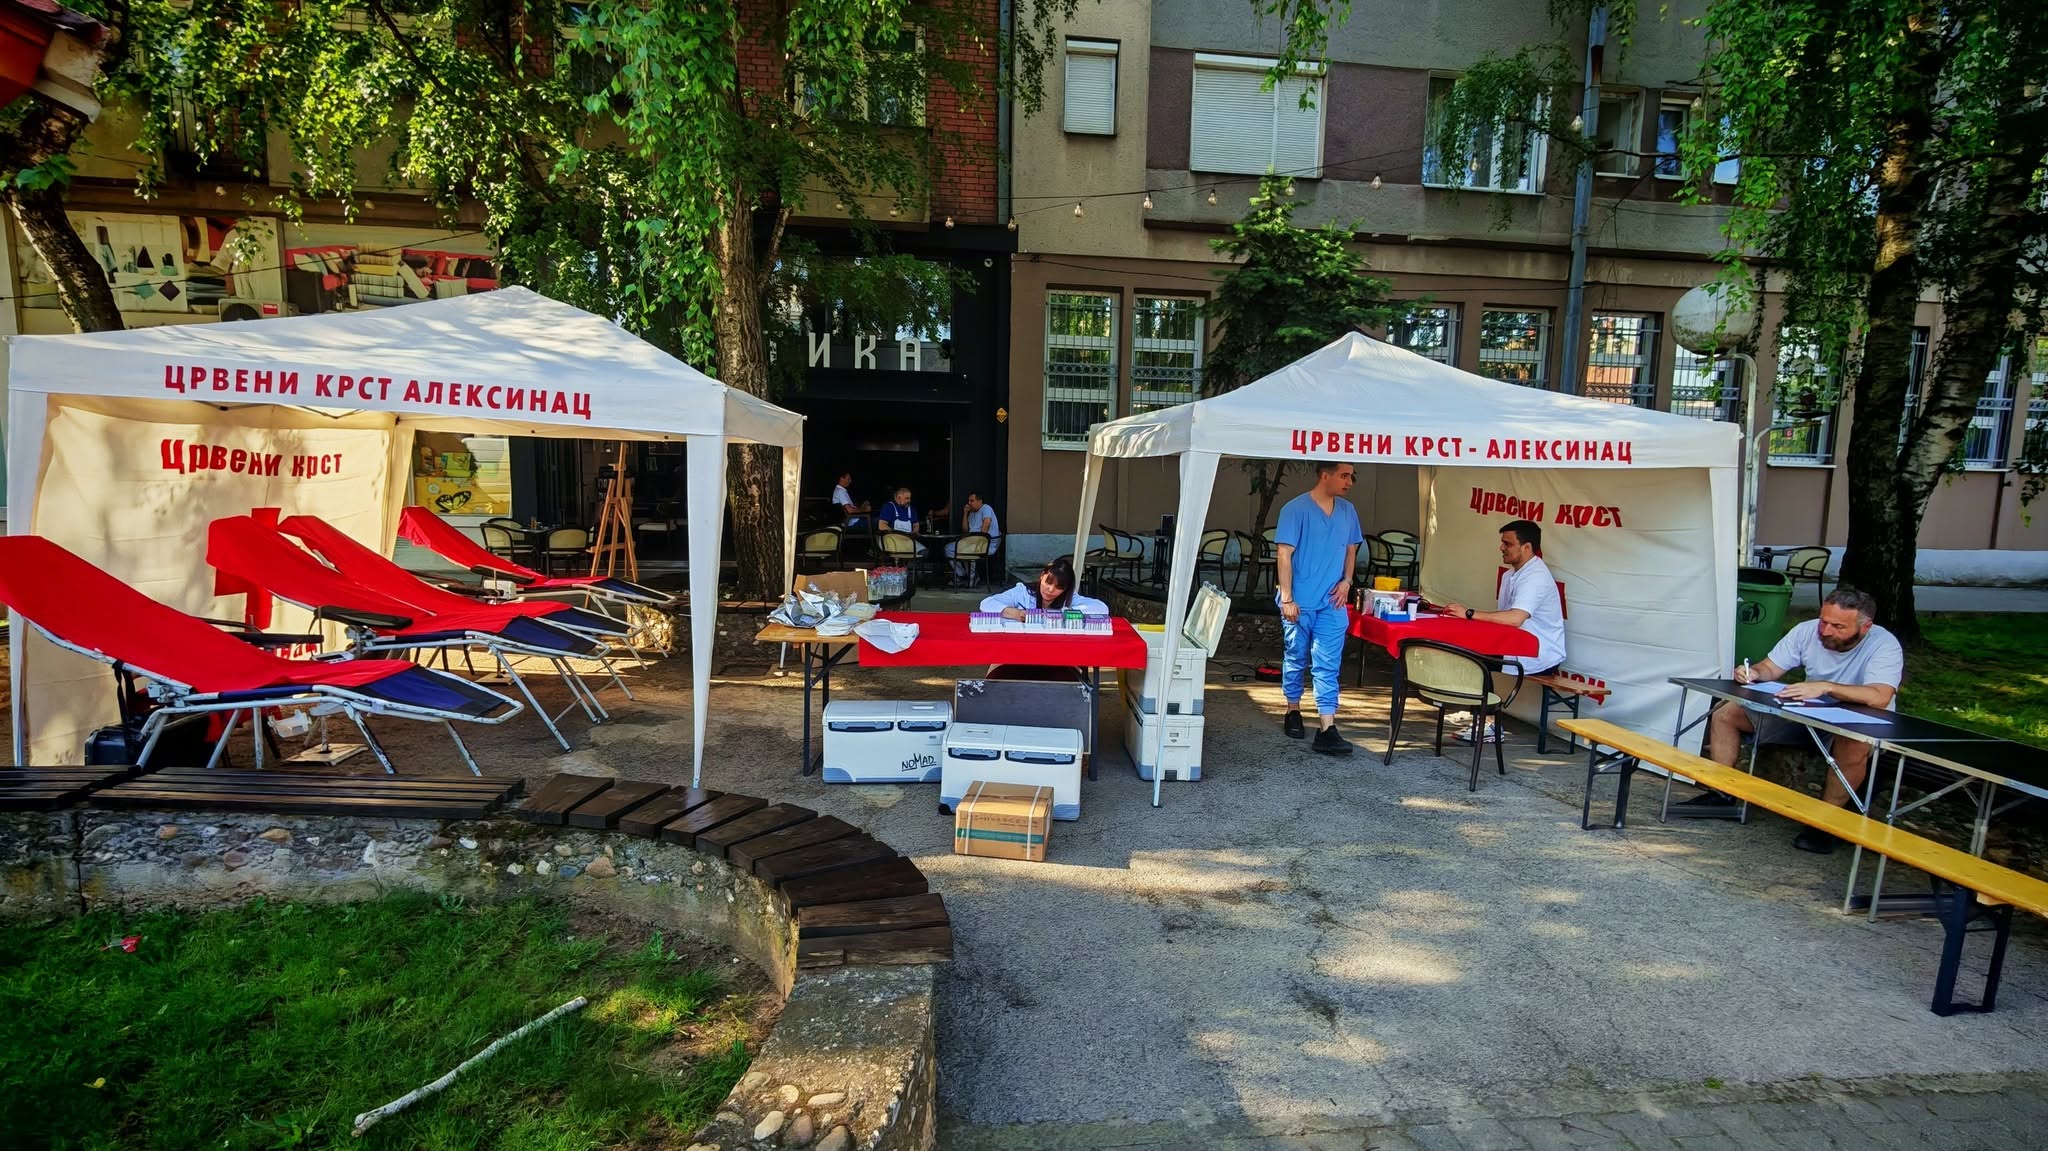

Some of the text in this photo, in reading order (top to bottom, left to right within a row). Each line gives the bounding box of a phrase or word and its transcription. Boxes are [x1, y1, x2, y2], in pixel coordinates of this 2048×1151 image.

[164, 365, 592, 420] ЦРВЕНИ КРСТ АЛЕКСИНАЦ
[160, 438, 343, 480] Црвени крст
[1290, 430, 1392, 456] ЦРВЕНИ
[1486, 438, 1632, 464] АЛЕКСИНАЦ
[1470, 487, 1623, 529] Црвени крст
